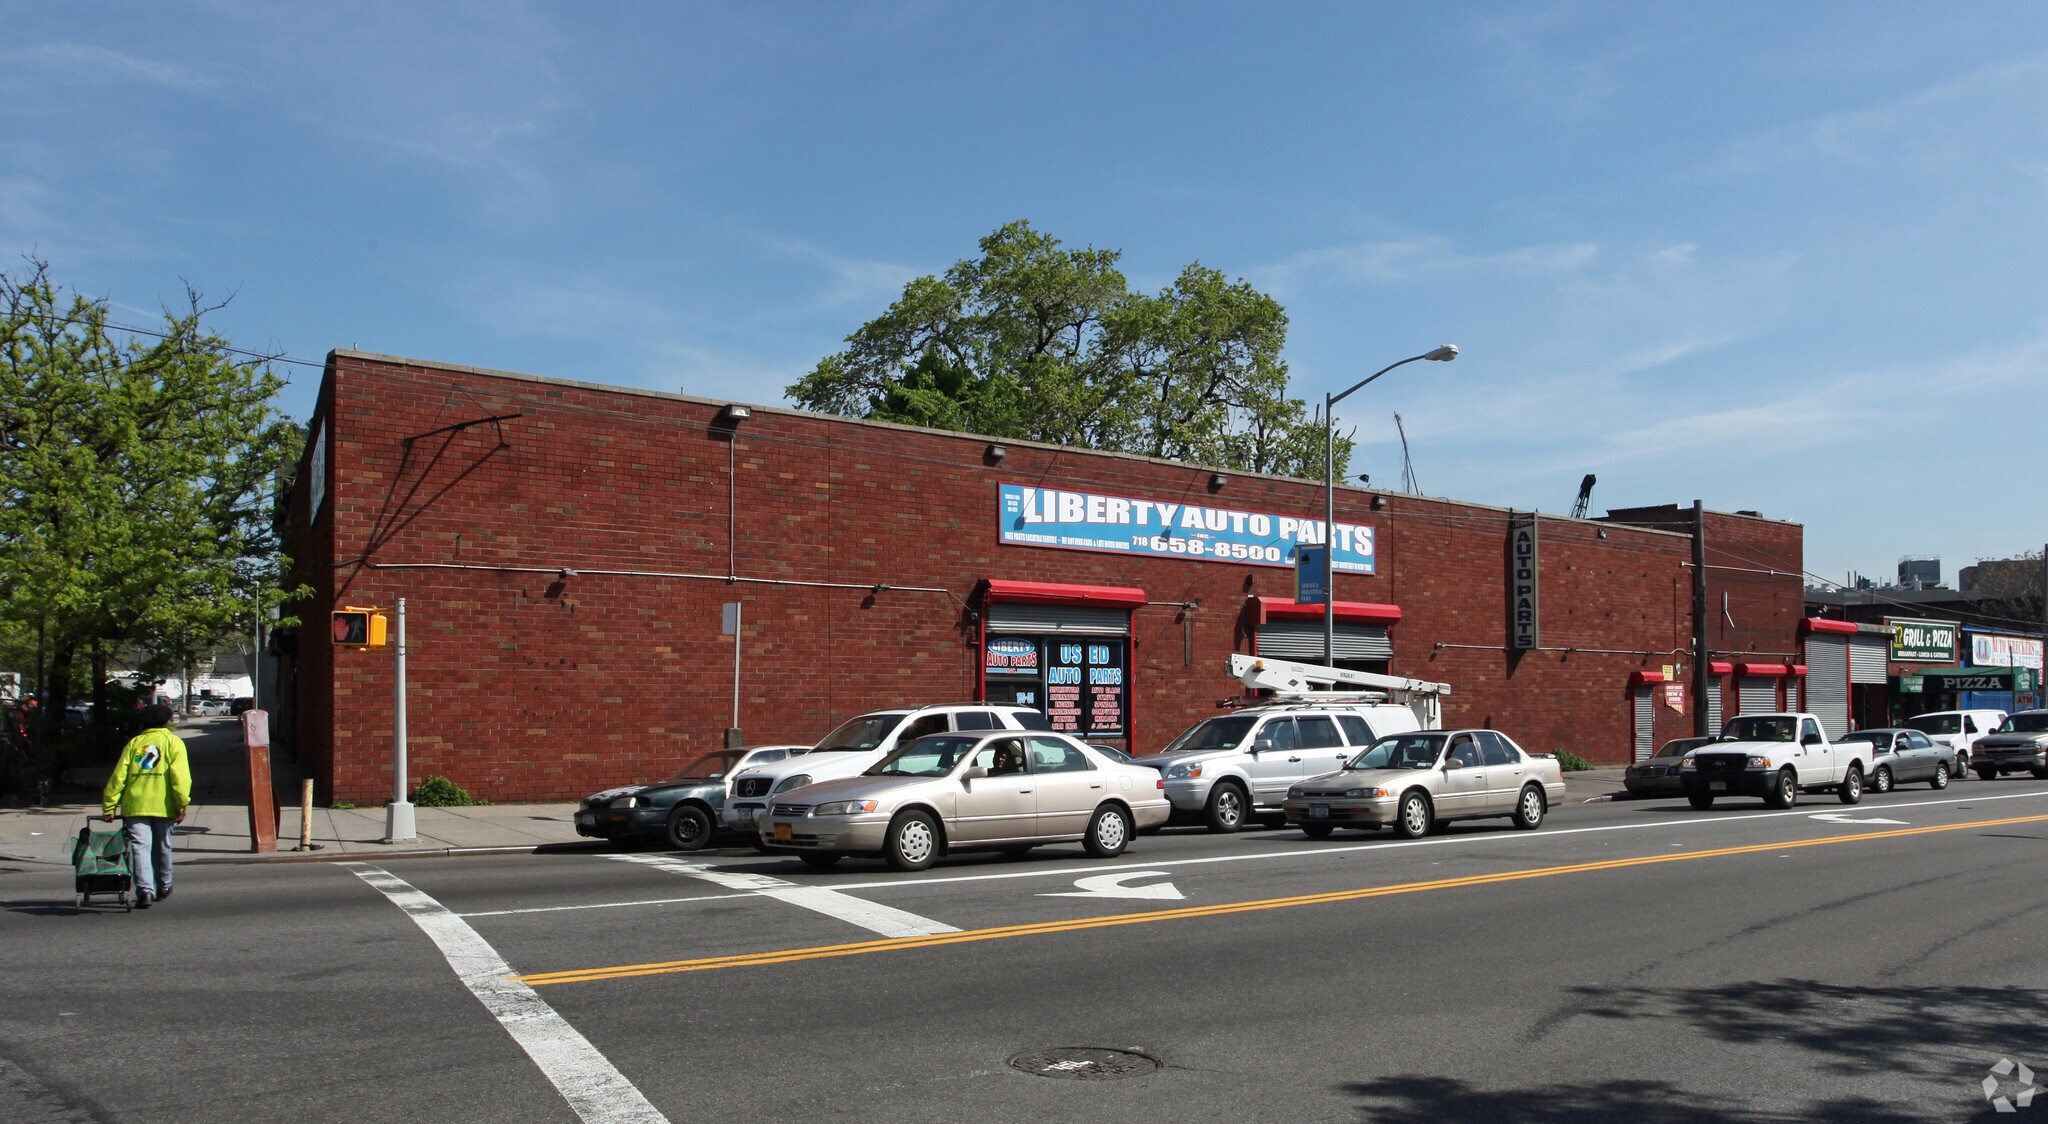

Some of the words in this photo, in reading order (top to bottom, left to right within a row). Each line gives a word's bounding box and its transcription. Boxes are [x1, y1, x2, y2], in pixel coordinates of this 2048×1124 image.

[1023, 487, 1180, 528] LIBERTY
[1181, 506, 1271, 536] AUTO
[1279, 517, 1373, 556] PARTS
[1132, 535, 1148, 547] 718
[1150, 535, 1281, 562] 658-8500
[1516, 531, 1532, 580] AUTO
[1516, 585, 1532, 646] PARTS
[992, 640, 1031, 652] LIBERTY
[1903, 628, 1925, 648] GRILL
[1932, 629, 1952, 648] PIZZA
[1992, 636, 2006, 654] AUTO
[986, 650, 1008, 666] AUTO
[1011, 652, 1037, 667] PARTS
[1048, 667, 1081, 684] AUTO
[1089, 668, 1122, 685] PARTS
[1943, 677, 2002, 689] PIZZA
[2016, 696, 2033, 704] ATM
